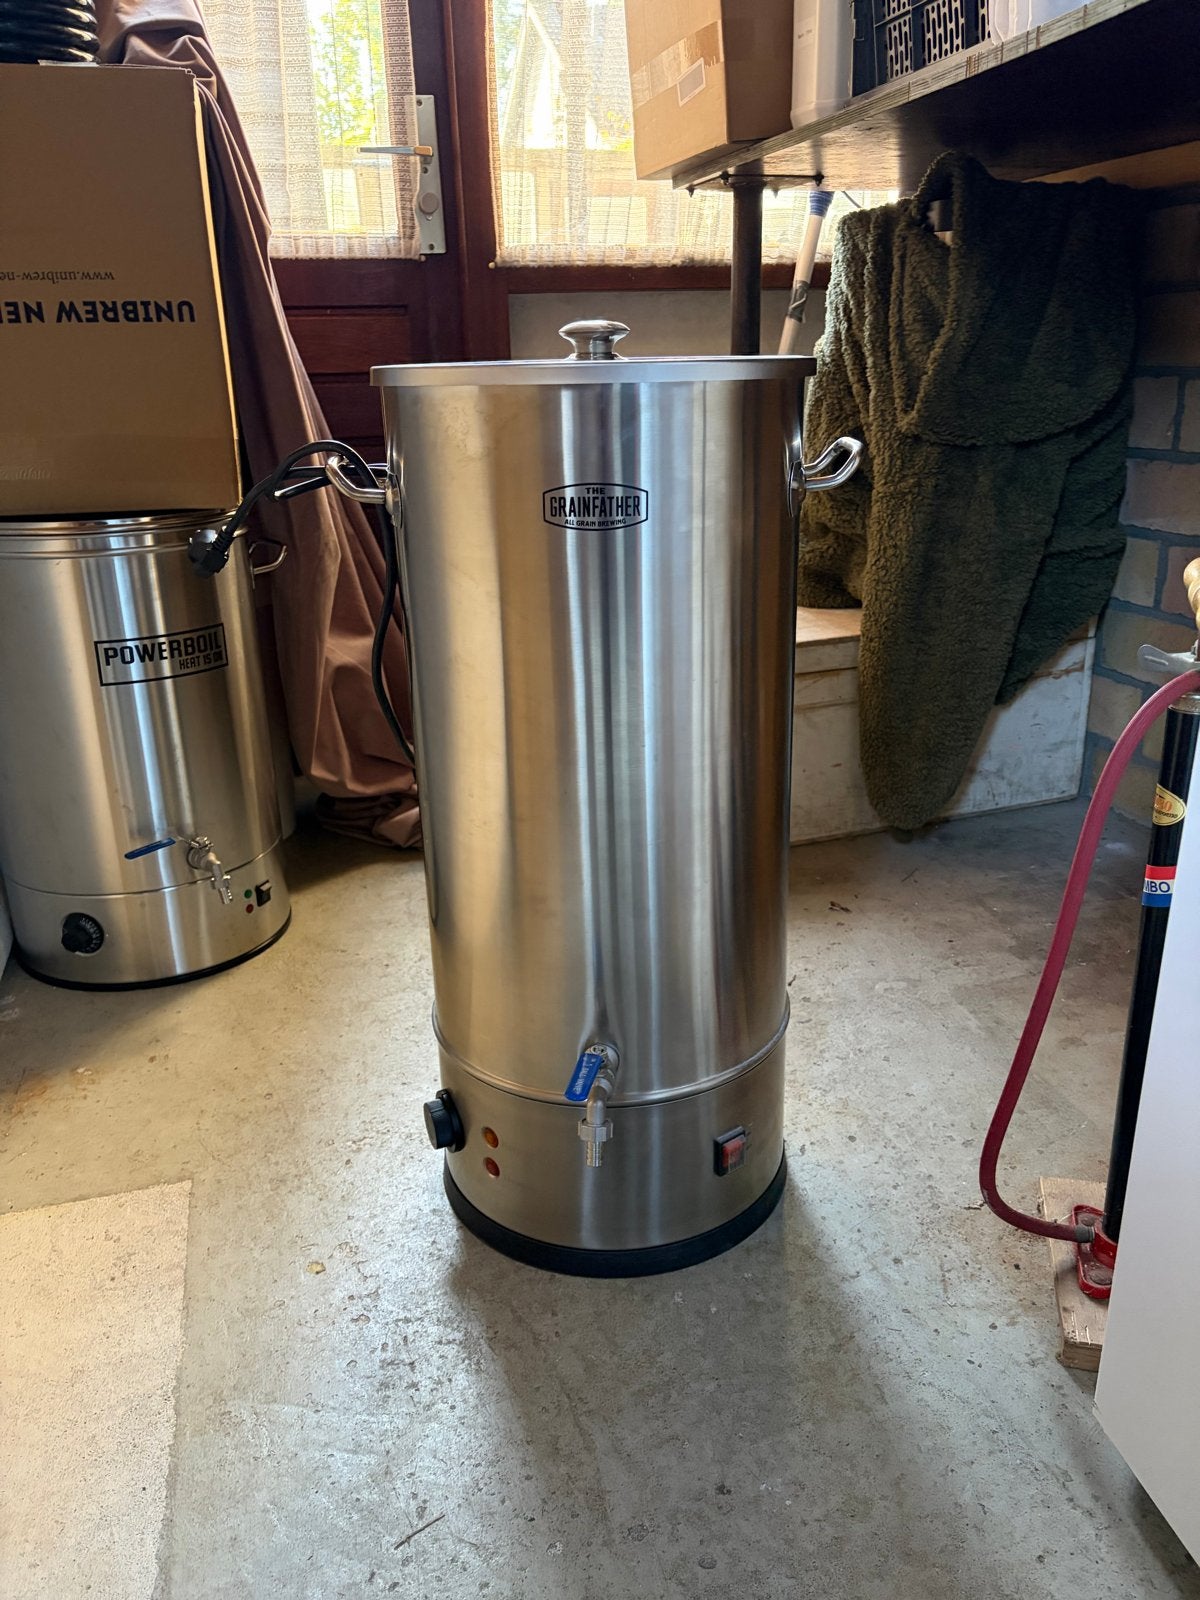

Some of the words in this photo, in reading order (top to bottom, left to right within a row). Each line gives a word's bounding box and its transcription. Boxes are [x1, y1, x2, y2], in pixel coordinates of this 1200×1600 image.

[0, 301, 45, 323] NE
[56, 301, 196, 323] UNIBREW
[585, 487, 606, 495] THE
[550, 495, 641, 518] GRAINFATHER
[597, 518, 627, 527] BREWING
[103, 631, 222, 666] POWERBOIL
[179, 656, 201, 670] HEAT
[203, 654, 211, 665] IS
